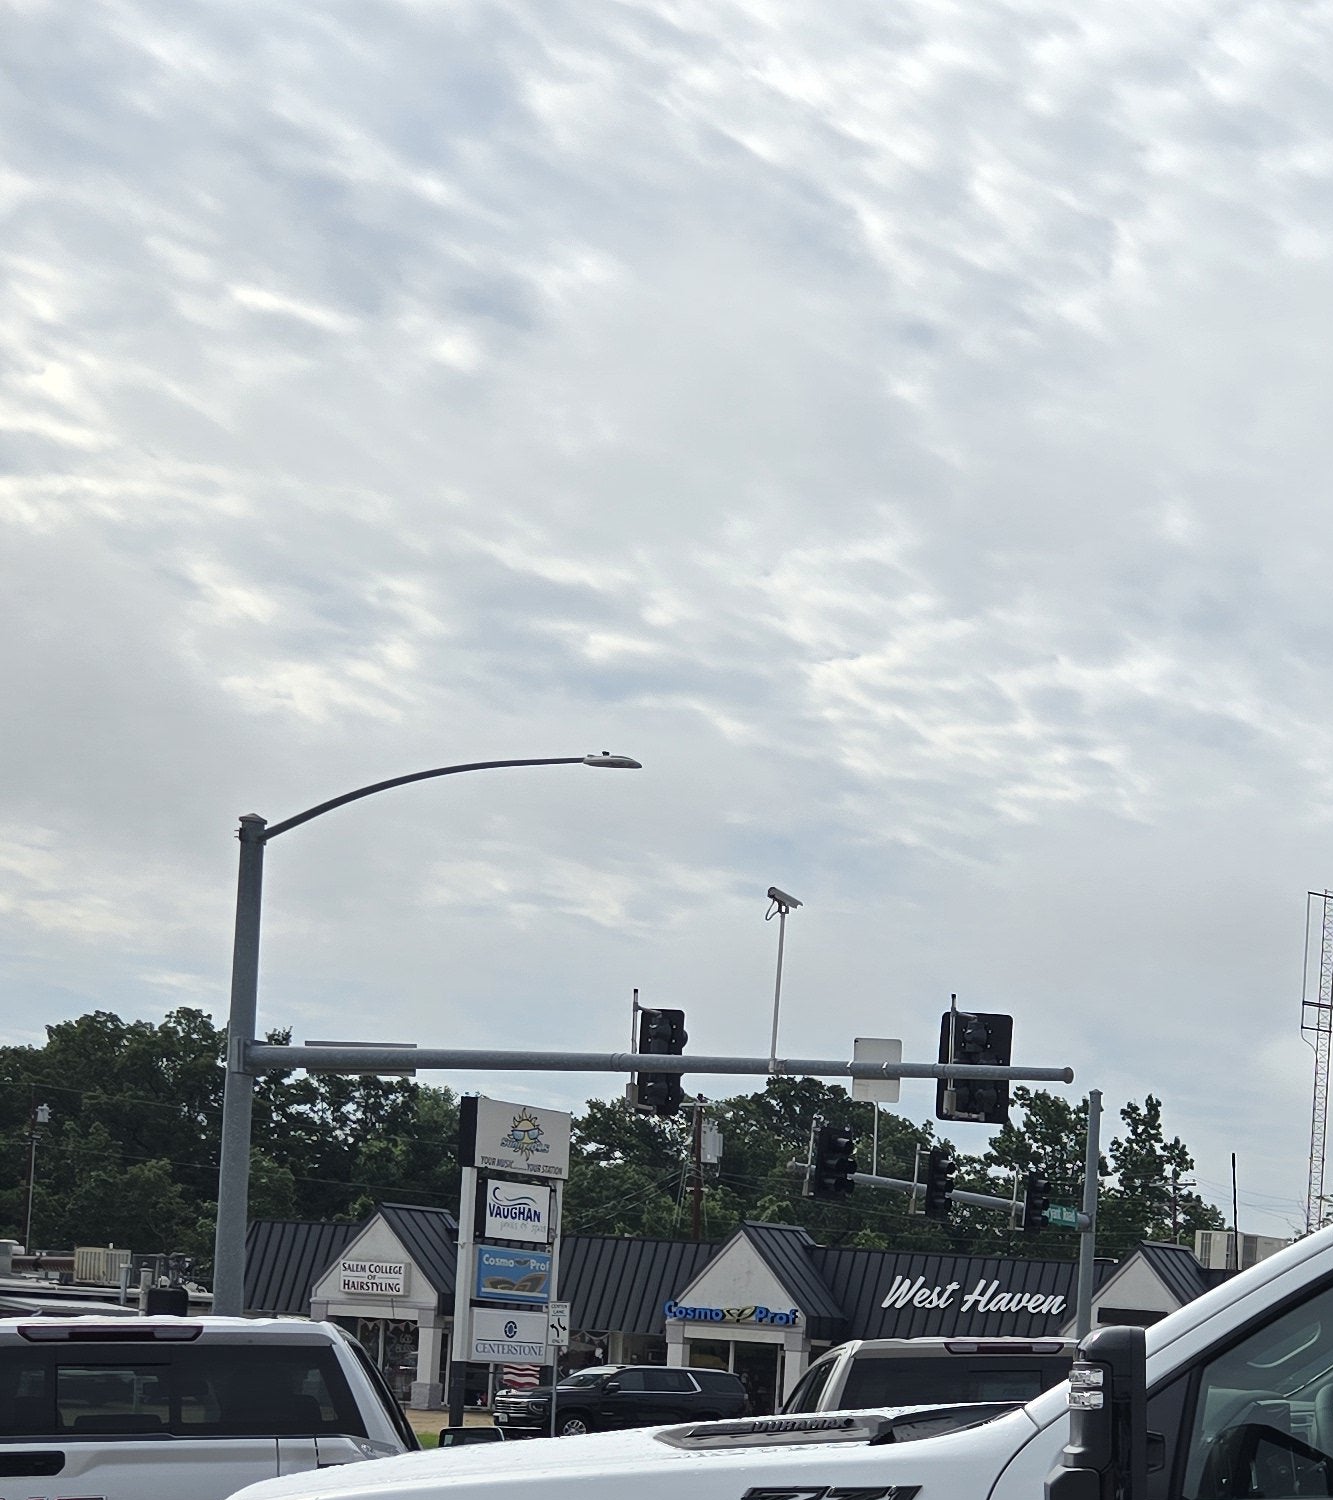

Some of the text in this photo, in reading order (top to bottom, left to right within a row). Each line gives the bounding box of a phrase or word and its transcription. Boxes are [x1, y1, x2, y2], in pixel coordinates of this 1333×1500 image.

[541, 1165, 562, 1175] STATION
[488, 1202, 541, 1223] VAUGHAN
[342, 1262, 402, 1275] SALEM COLLEGE
[482, 1254, 550, 1272] Cosmo Prof
[342, 1279, 401, 1293] HAIRSTYLING
[881, 1275, 1067, 1315] West Haven
[664, 1300, 799, 1326] Cosmo Prof
[475, 1342, 544, 1357] CENTERSTONE
[752, 1418, 854, 1432] DURAMAX
